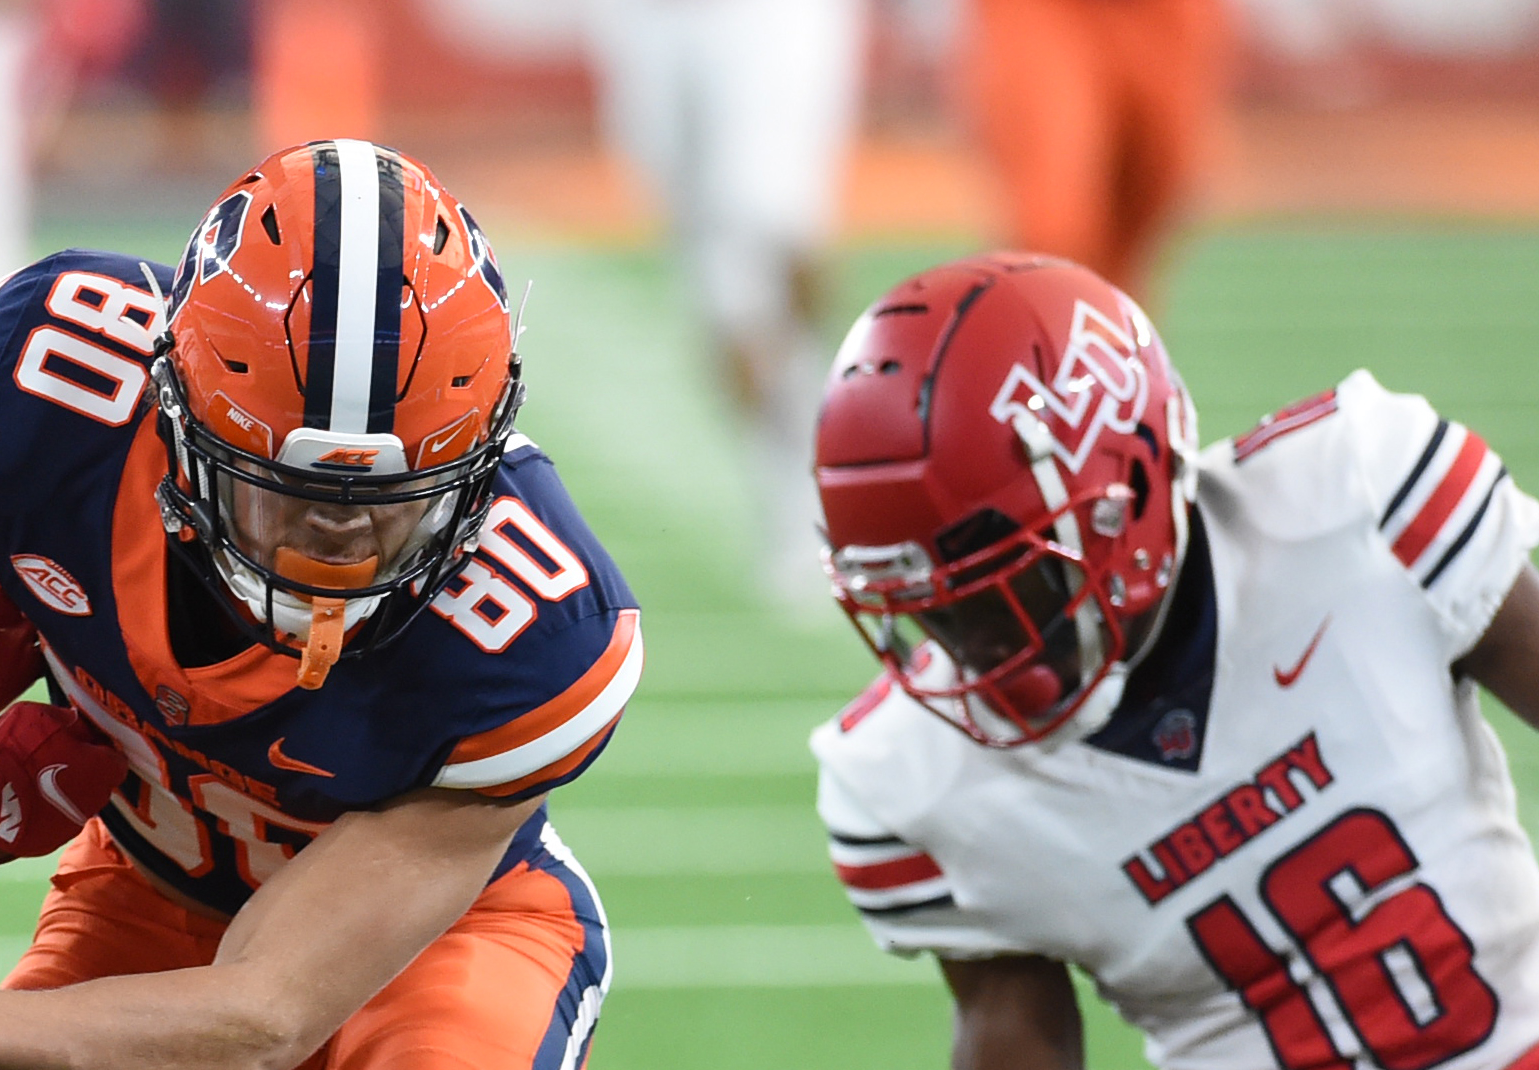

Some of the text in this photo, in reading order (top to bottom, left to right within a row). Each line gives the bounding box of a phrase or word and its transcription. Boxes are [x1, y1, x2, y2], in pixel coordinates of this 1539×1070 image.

[13, 270, 170, 428] 80
[225, 407, 255, 432] NIKE
[317, 447, 379, 466] ACC
[16, 566, 86, 607] ACC
[1120, 729, 1335, 908] LIBERTY
